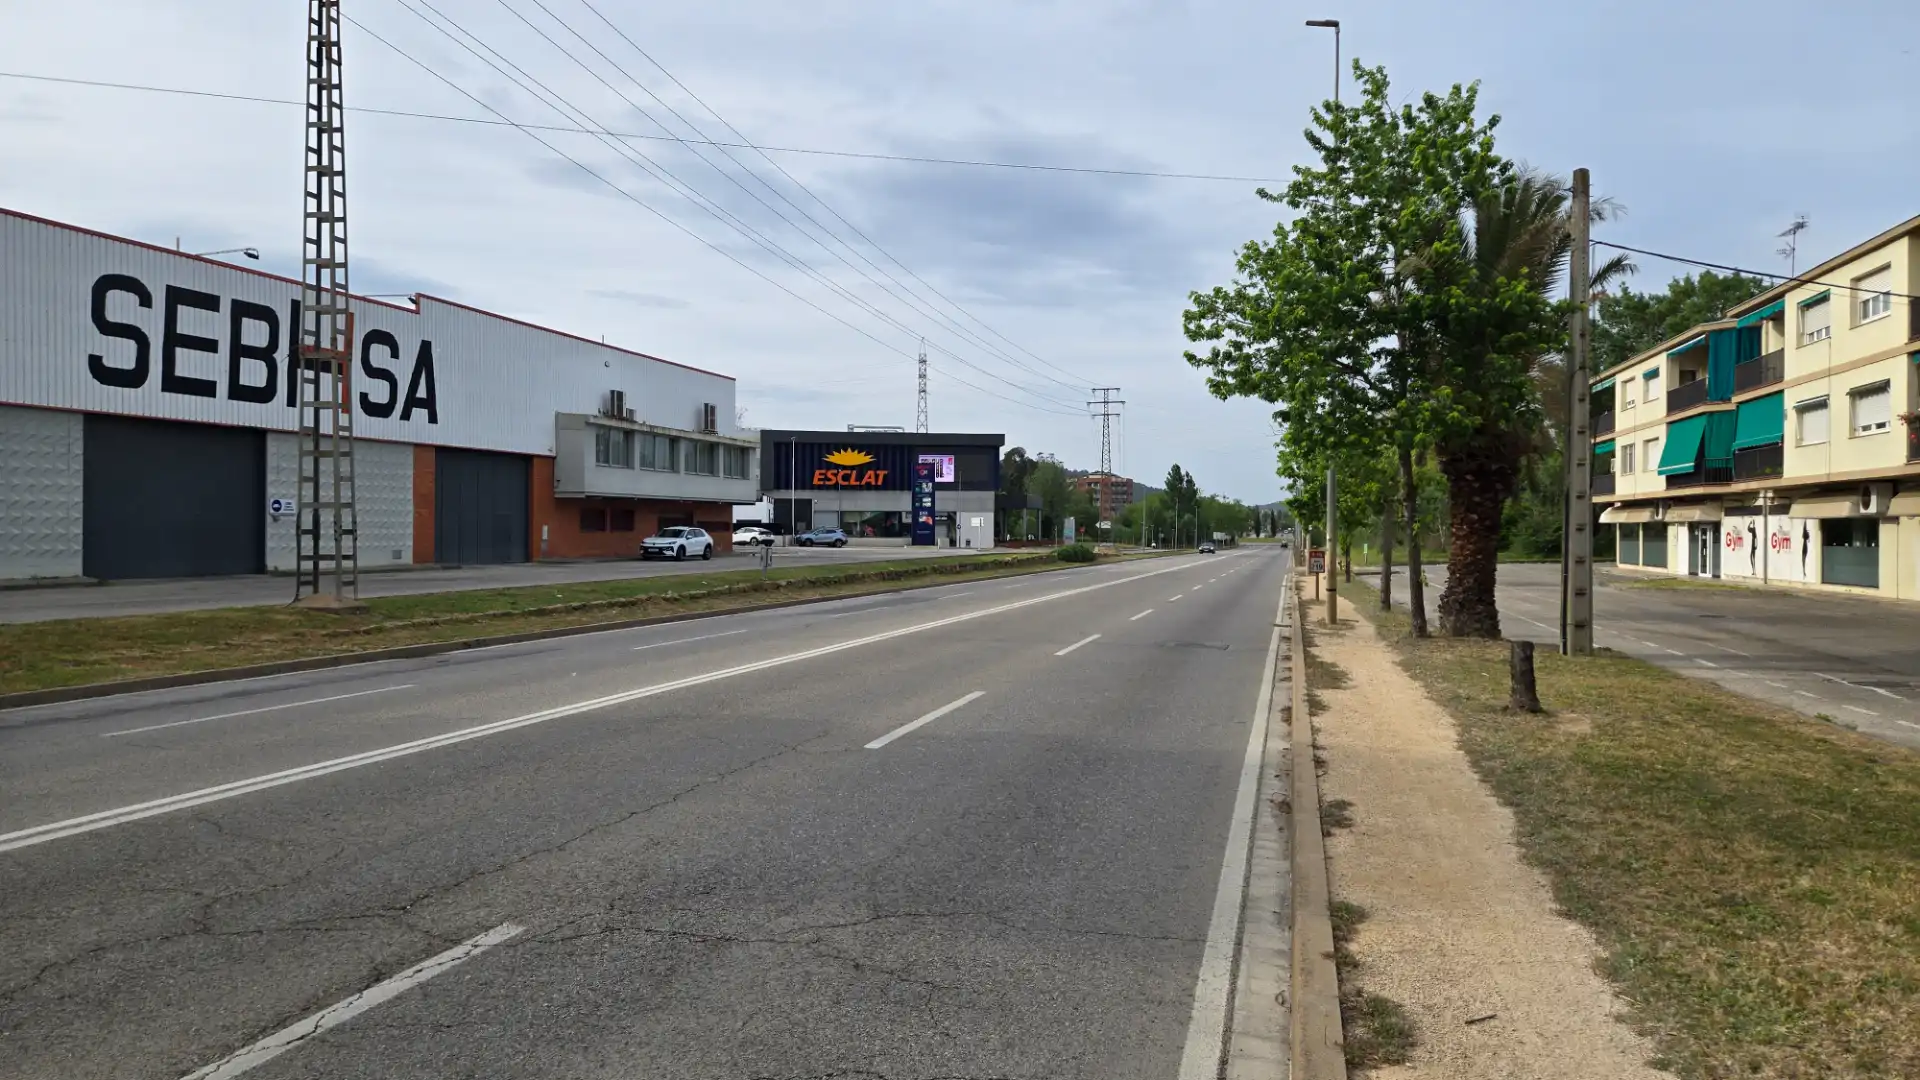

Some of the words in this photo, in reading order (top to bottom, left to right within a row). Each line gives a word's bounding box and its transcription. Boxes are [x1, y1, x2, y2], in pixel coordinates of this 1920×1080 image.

[812, 469, 888, 485] ESCLAT
[1725, 532, 1743, 551] Gym
[1771, 533, 1791, 554] Gym
